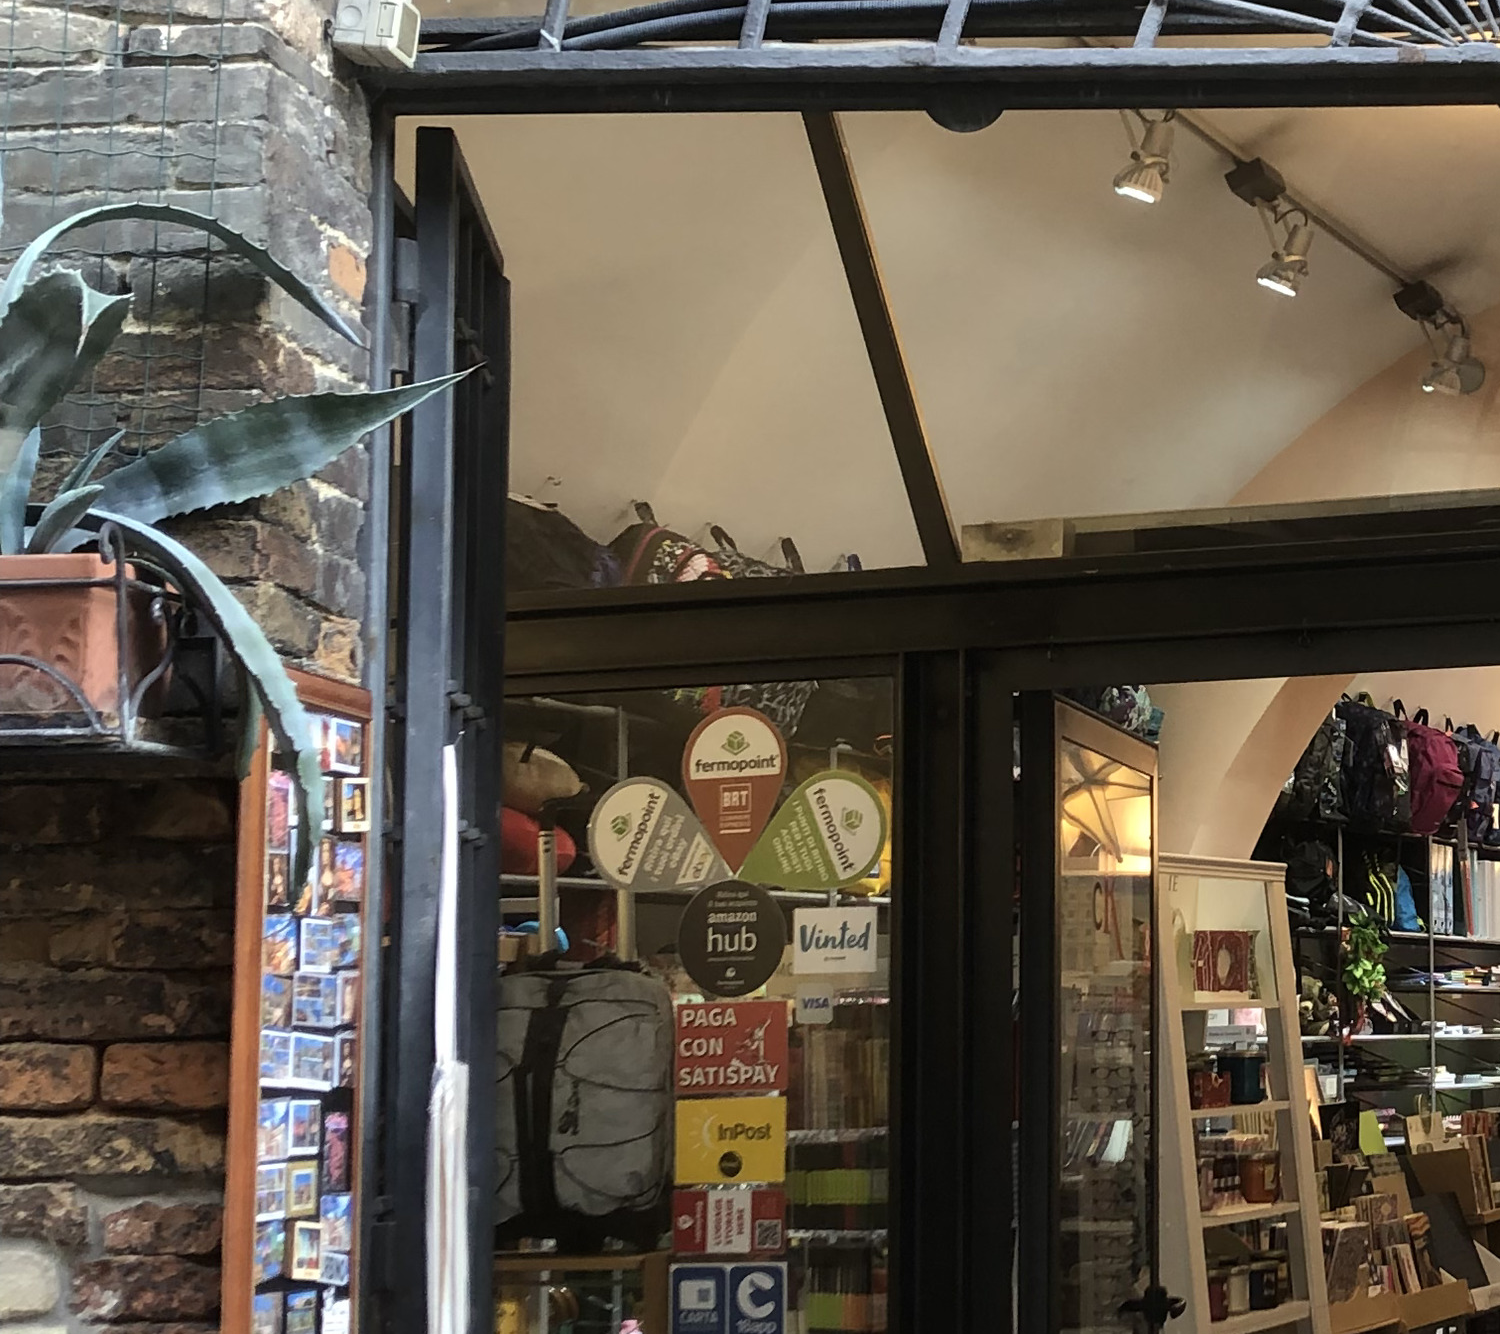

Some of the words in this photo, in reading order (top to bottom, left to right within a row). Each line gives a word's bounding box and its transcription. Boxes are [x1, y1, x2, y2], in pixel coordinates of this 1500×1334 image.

[695, 755, 776, 773] fermopoint
[722, 791, 749, 807] BRT
[617, 791, 661, 877] fermopoint
[812, 788, 855, 873] fermopoint
[707, 911, 757, 924] amazon
[707, 926, 757, 953] hub
[800, 920, 872, 953] Vinted
[802, 997, 829, 1009] VISA
[681, 1008, 738, 1028] PAGA
[679, 1037, 723, 1057] CON
[679, 1064, 779, 1087] SATISPAY
[717, 1123, 772, 1142] InPost
